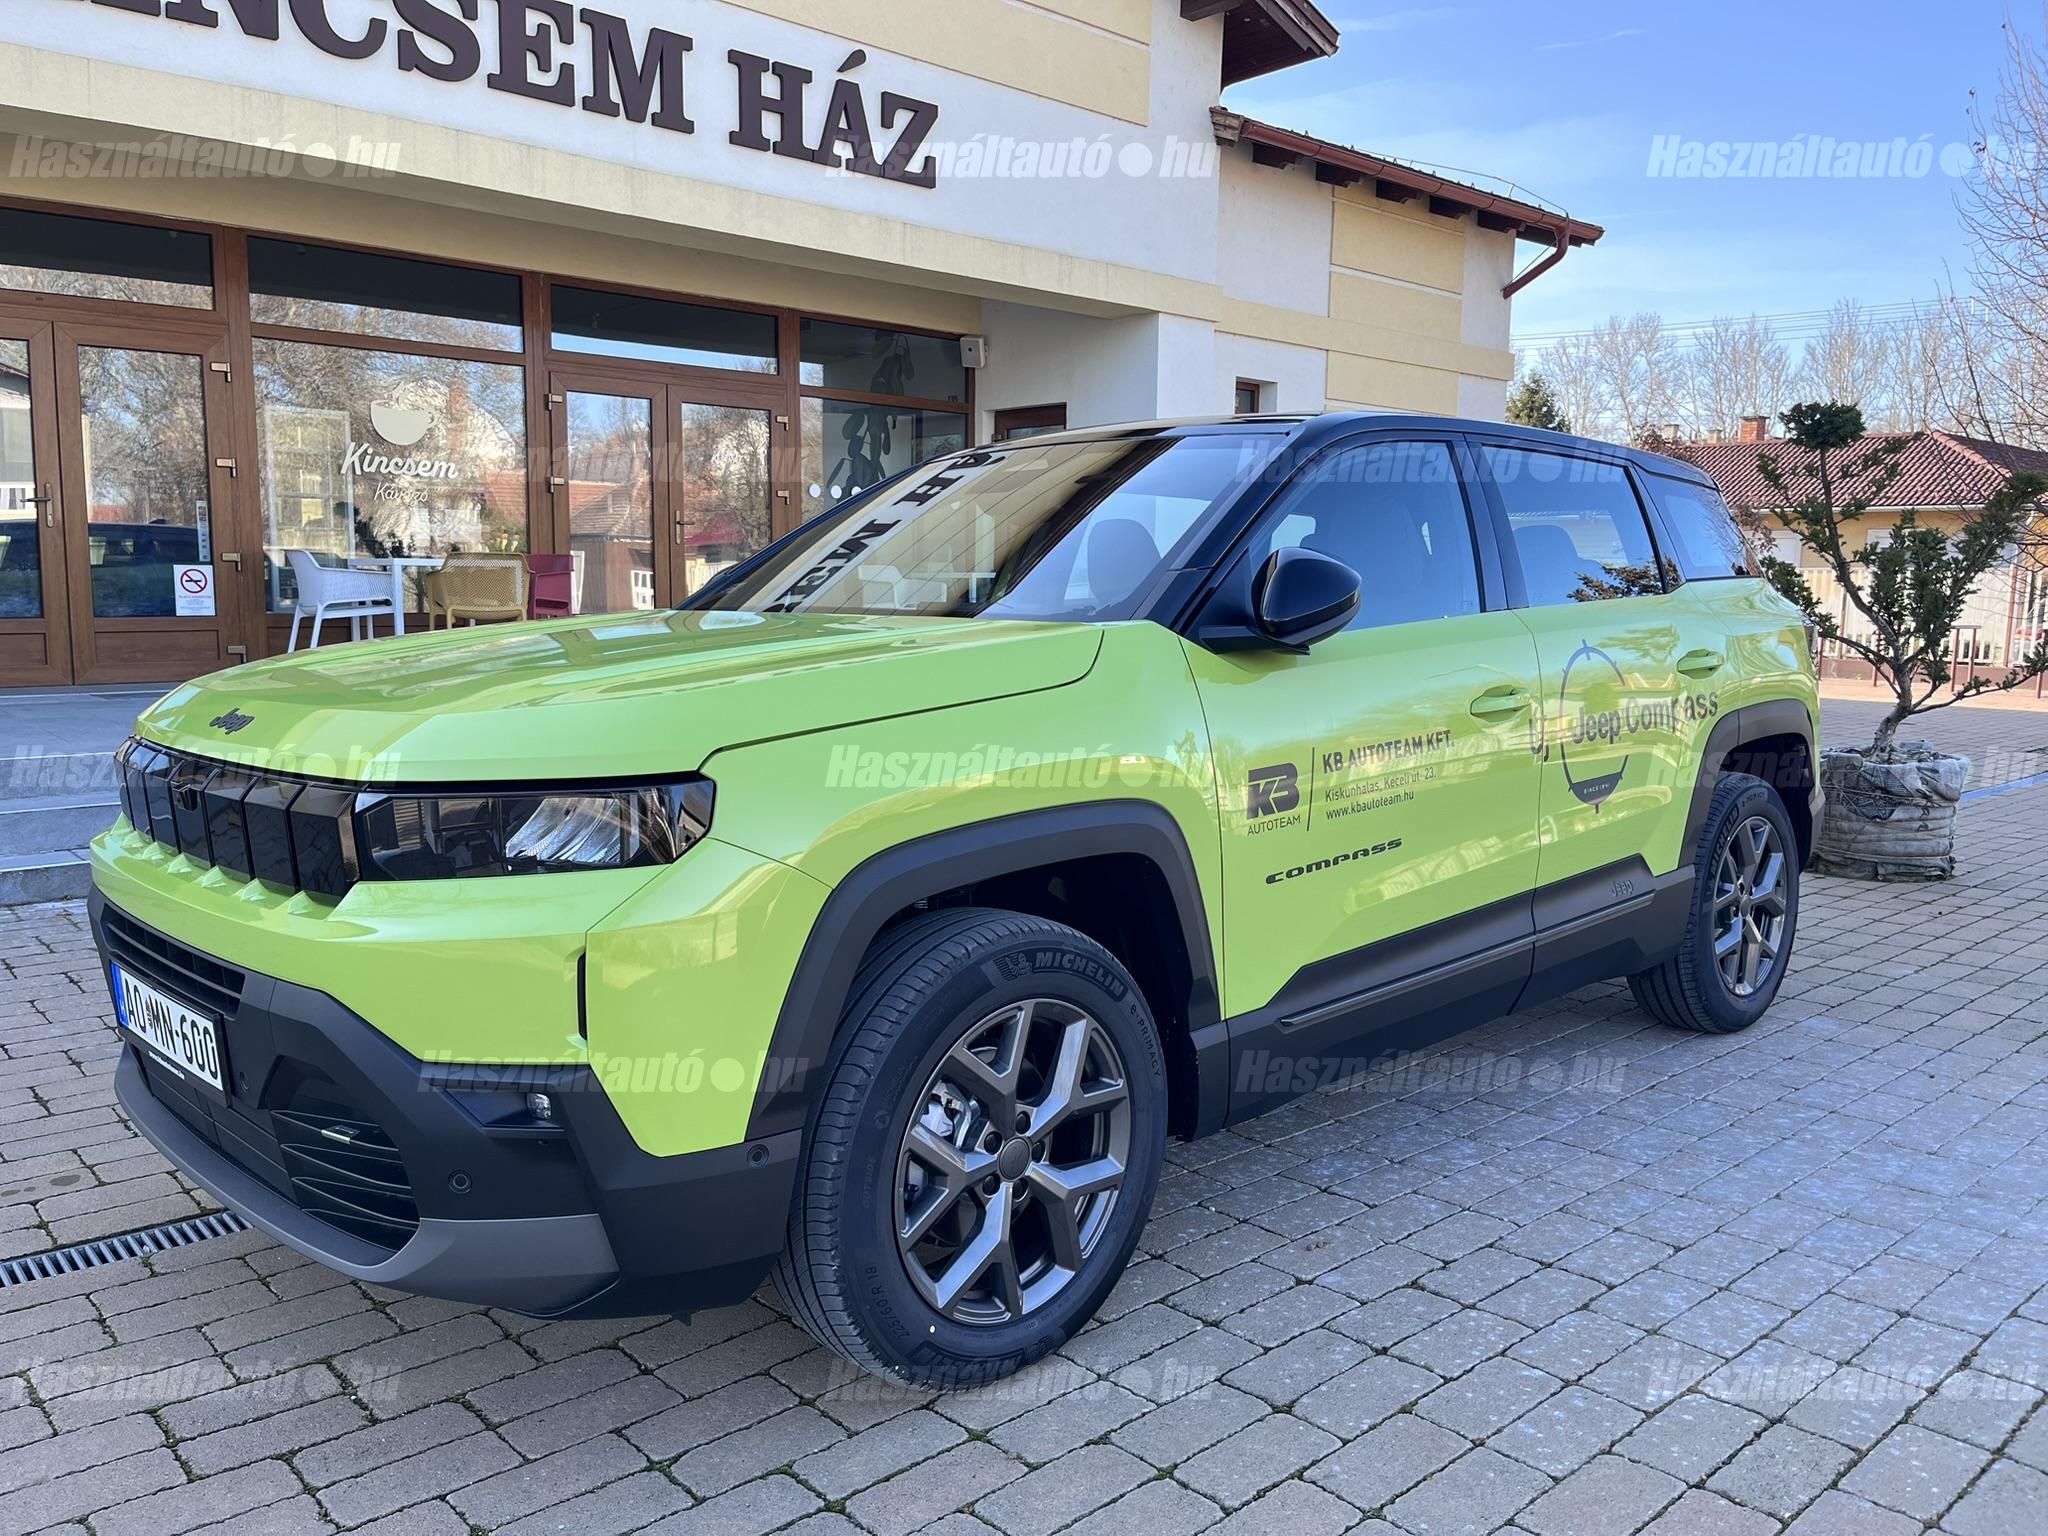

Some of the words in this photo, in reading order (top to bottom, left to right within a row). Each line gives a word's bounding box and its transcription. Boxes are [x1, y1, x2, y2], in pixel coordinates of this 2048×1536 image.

[728, 48, 937, 189] HÁZ
[340, 441, 459, 480] Kincsem
[208, 706, 256, 736] Jeep
[1572, 706, 1620, 745] Jeep
[1626, 691, 1718, 735] Compass
[1323, 751, 1344, 774] KB
[1348, 735, 1424, 769] AUTOTEAM
[1426, 730, 1455, 753] KFT.
[1247, 762, 1300, 820] KB
[1325, 780, 1382, 803] Kiskunhalas,
[1326, 790, 1415, 820] www.kbautoteam.hu
[1247, 814, 1301, 836] AUTOTEAM
[1035, 951, 1125, 997] MICHELIN
